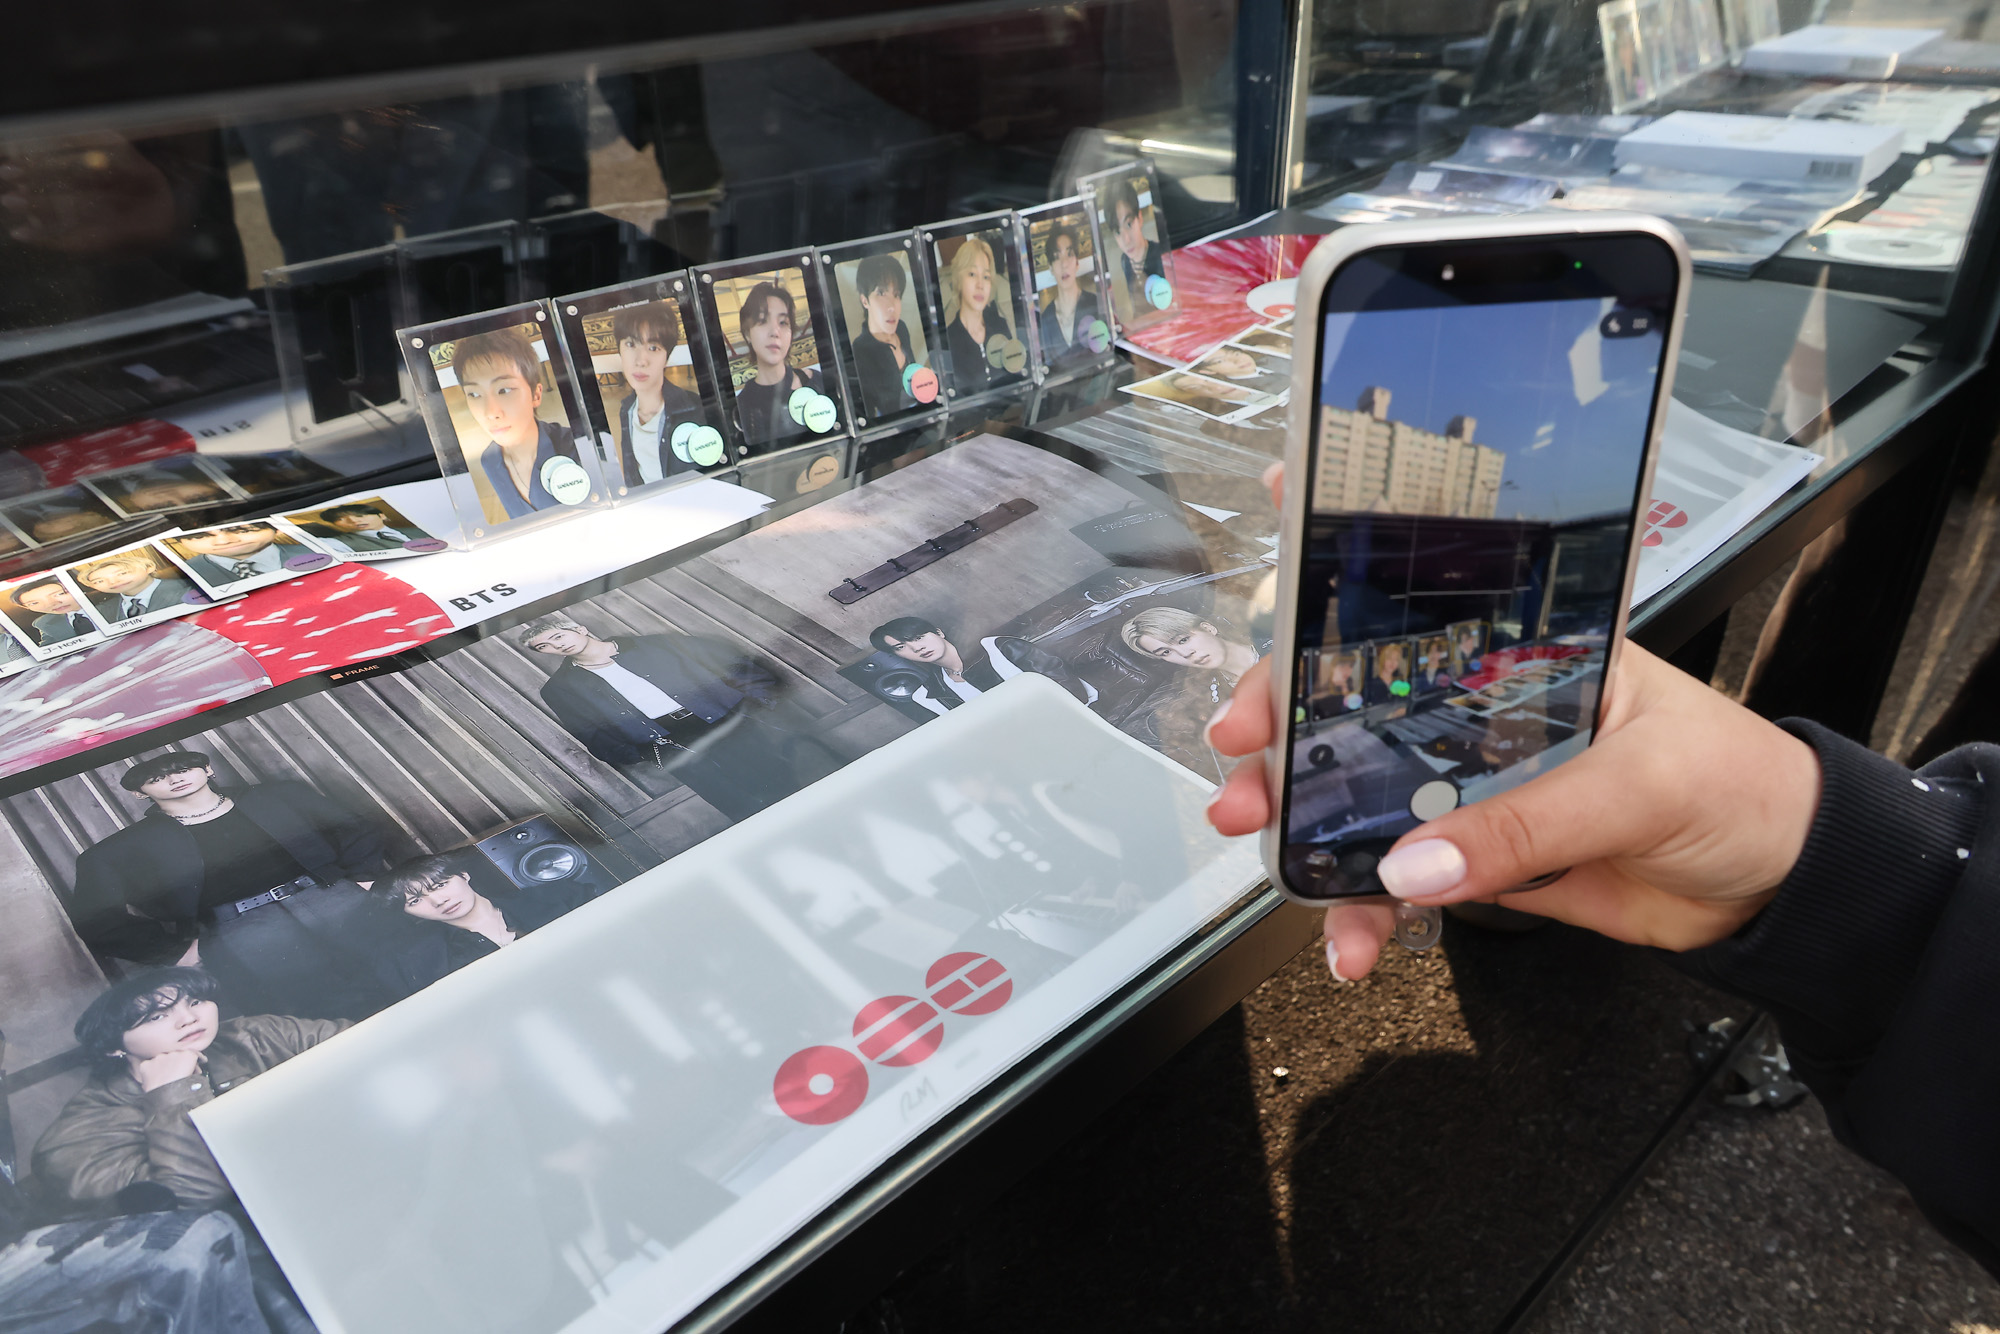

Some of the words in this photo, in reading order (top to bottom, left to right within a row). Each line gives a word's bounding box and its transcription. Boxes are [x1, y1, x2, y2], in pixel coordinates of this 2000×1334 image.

[694, 439, 717, 451] weverse
[557, 478, 584, 490] weverse
[449, 583, 517, 612] BTS
[116, 617, 143, 628] JIMIN
[43, 638, 87, 655] J-HOPE
[345, 665, 380, 677] FRAME
